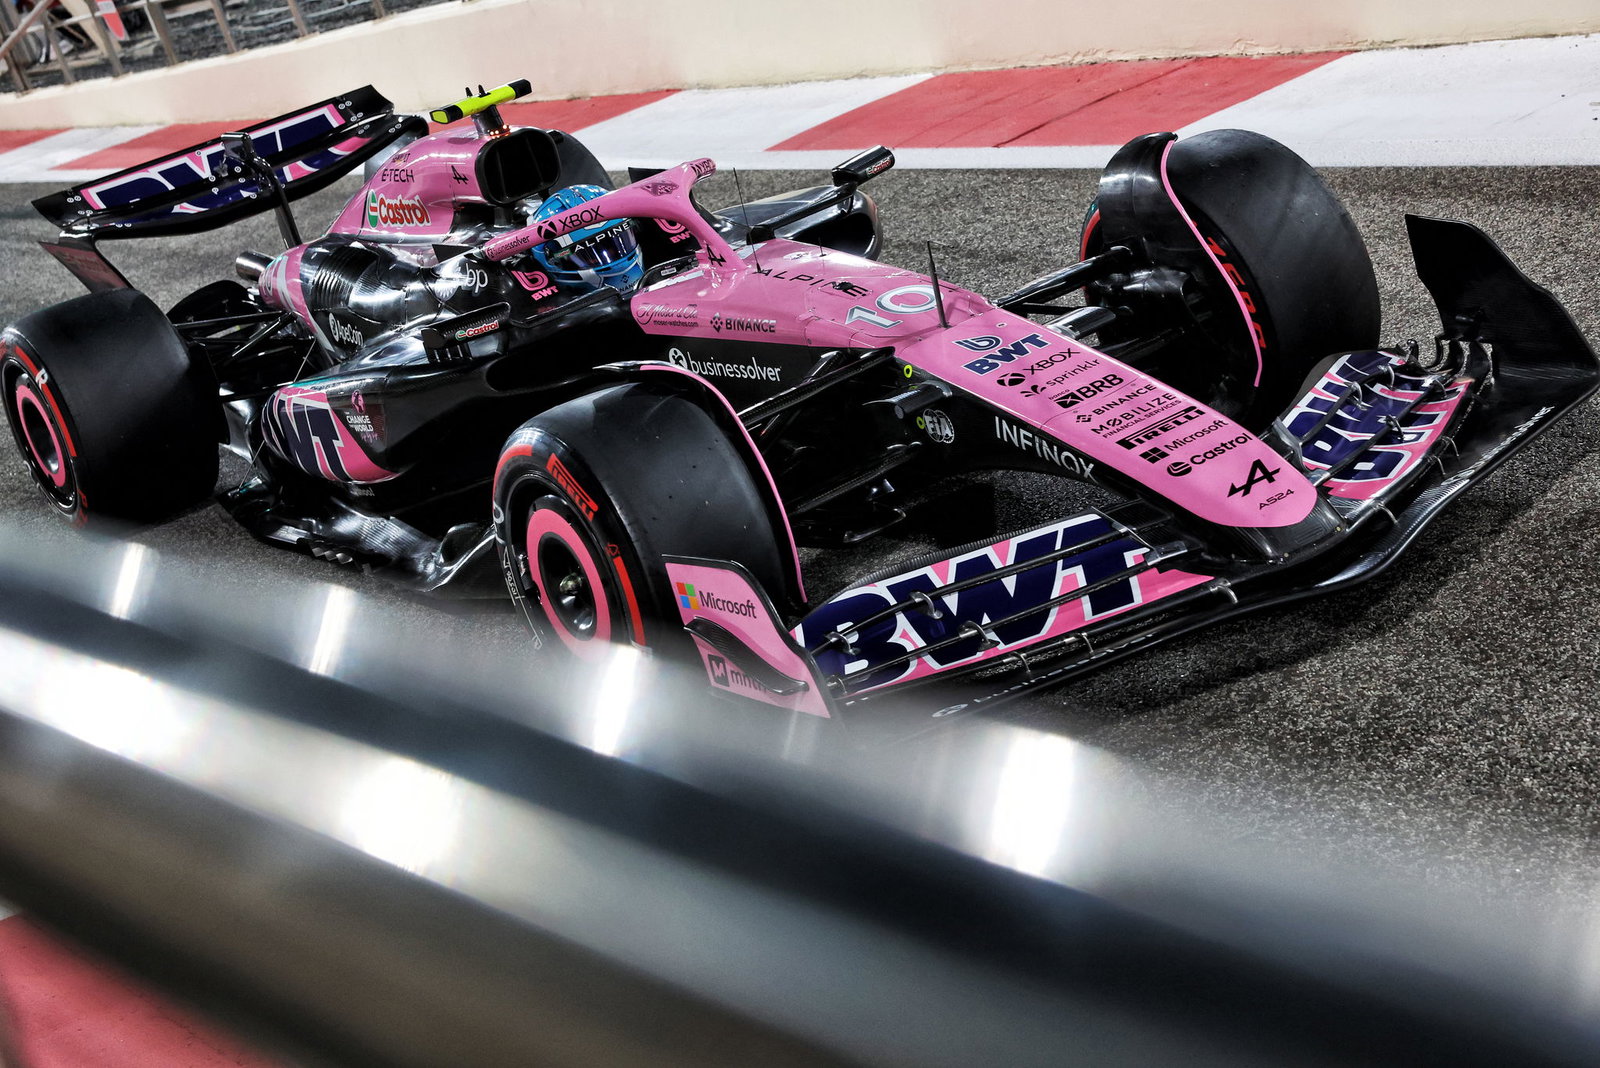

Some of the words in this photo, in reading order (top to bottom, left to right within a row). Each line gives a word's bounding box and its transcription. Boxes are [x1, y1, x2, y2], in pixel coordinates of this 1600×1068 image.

[381, 168, 415, 183] E-TECH
[378, 195, 431, 225] Castrol
[558, 205, 605, 231] XBOX
[574, 222, 630, 253] ALPINE
[465, 262, 489, 294] bp
[531, 285, 559, 301] BWT
[845, 284, 945, 329] 10
[337, 319, 364, 348] ApeCoin
[465, 320, 500, 338] Castrol
[725, 318, 777, 333] BINANCE
[687, 351, 780, 382] businessolver
[962, 332, 1052, 377] BWT
[1022, 347, 1081, 375] XBOX
[1046, 359, 1101, 388] sprinklr
[1076, 373, 1124, 400] BRB
[1048, 388, 1071, 401] banco
[1092, 383, 1157, 416] BINANCE
[346, 415, 371, 424] CHANGE
[355, 424, 374, 432] WORLD
[1102, 415, 1147, 439] FINANCIAL
[1145, 399, 1182, 419] SERVICES
[1115, 405, 1206, 450] PIRELLI
[994, 415, 1098, 483] INFINOX
[1164, 419, 1229, 451] Microsoft
[1189, 432, 1253, 465] Castrol
[545, 452, 599, 522] PIRELLI
[1258, 488, 1295, 510] A524
[698, 590, 757, 619] Microsoft
[795, 513, 1151, 693] BWT
